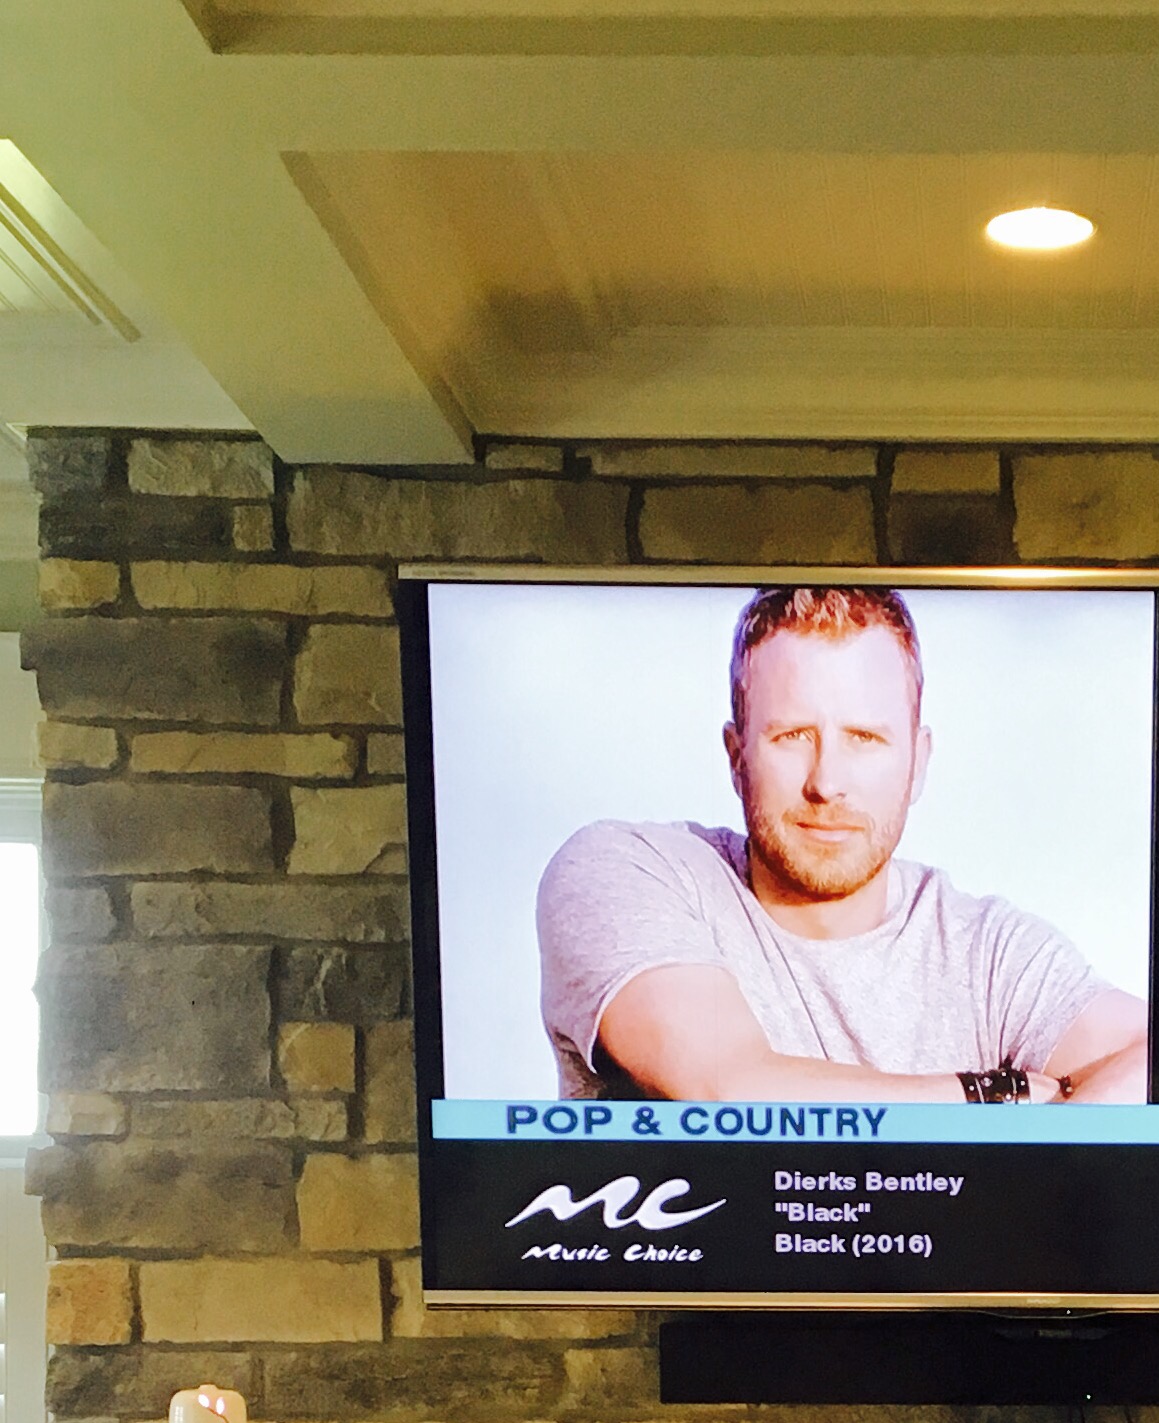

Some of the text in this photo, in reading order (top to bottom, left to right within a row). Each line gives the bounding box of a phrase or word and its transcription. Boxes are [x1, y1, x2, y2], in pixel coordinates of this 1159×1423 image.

[506, 1105, 887, 1137] POP & COUNTRY
[774, 1170, 965, 1196] Dierks Bentley
[775, 1202, 871, 1222] "Black"
[521, 1243, 704, 1262] Music Choice
[775, 1233, 933, 1258] Black (2016)
